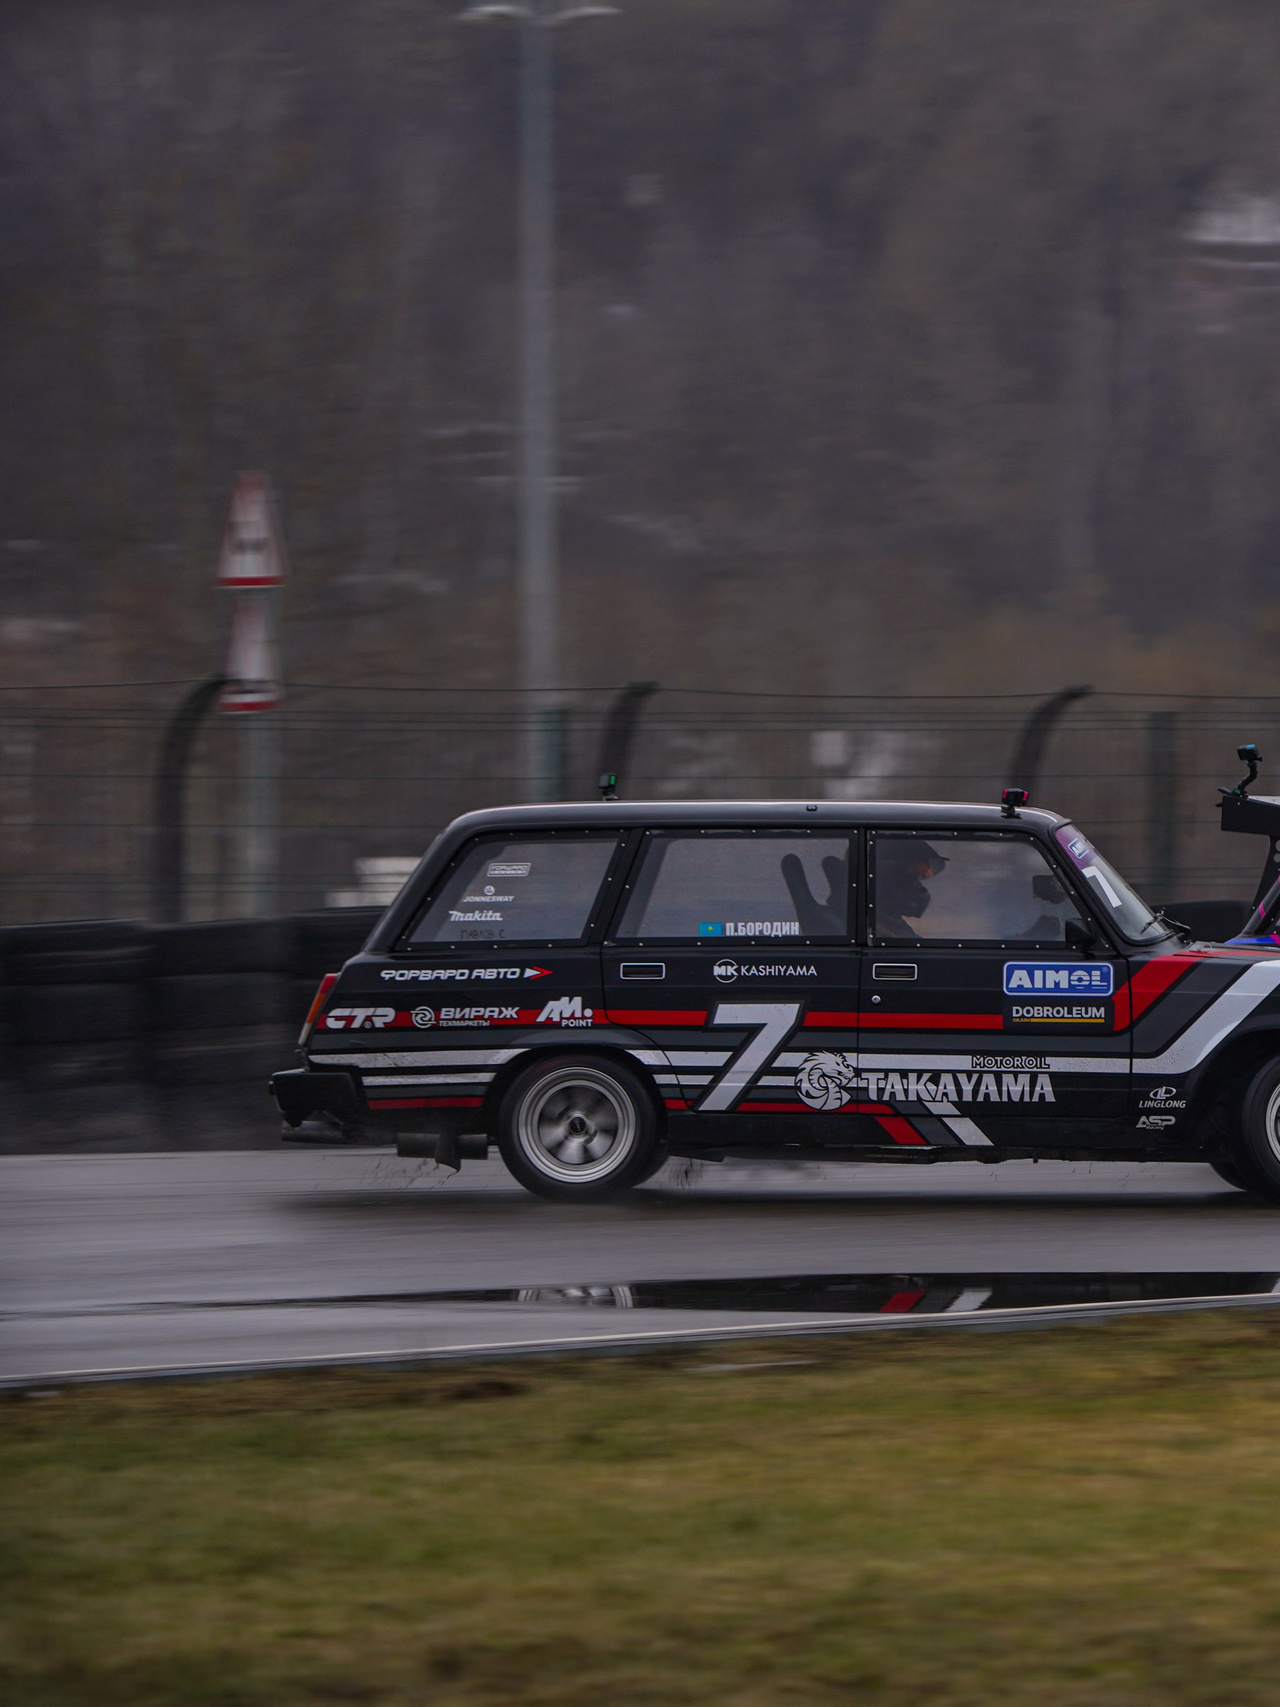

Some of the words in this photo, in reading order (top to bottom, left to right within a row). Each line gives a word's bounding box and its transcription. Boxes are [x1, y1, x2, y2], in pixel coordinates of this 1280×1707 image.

[1081, 865, 1122, 908] 7
[726, 922, 799, 937] П.БОРОДИН
[471, 968, 521, 980] АВТО
[741, 965, 818, 976] KASHIYAMA
[1008, 969, 1108, 989] AIMOL
[326, 1007, 396, 1029] CTR
[439, 1007, 521, 1019] ВИРАЖ
[1012, 1006, 1105, 1018] DOBROLEUM
[561, 1019, 593, 1027] POINT
[698, 1003, 800, 1111] 7
[861, 1072, 1056, 1102] TAKAYAMA
[1138, 1100, 1186, 1108] LINGLONG
[1136, 1115, 1176, 1128] ASP
